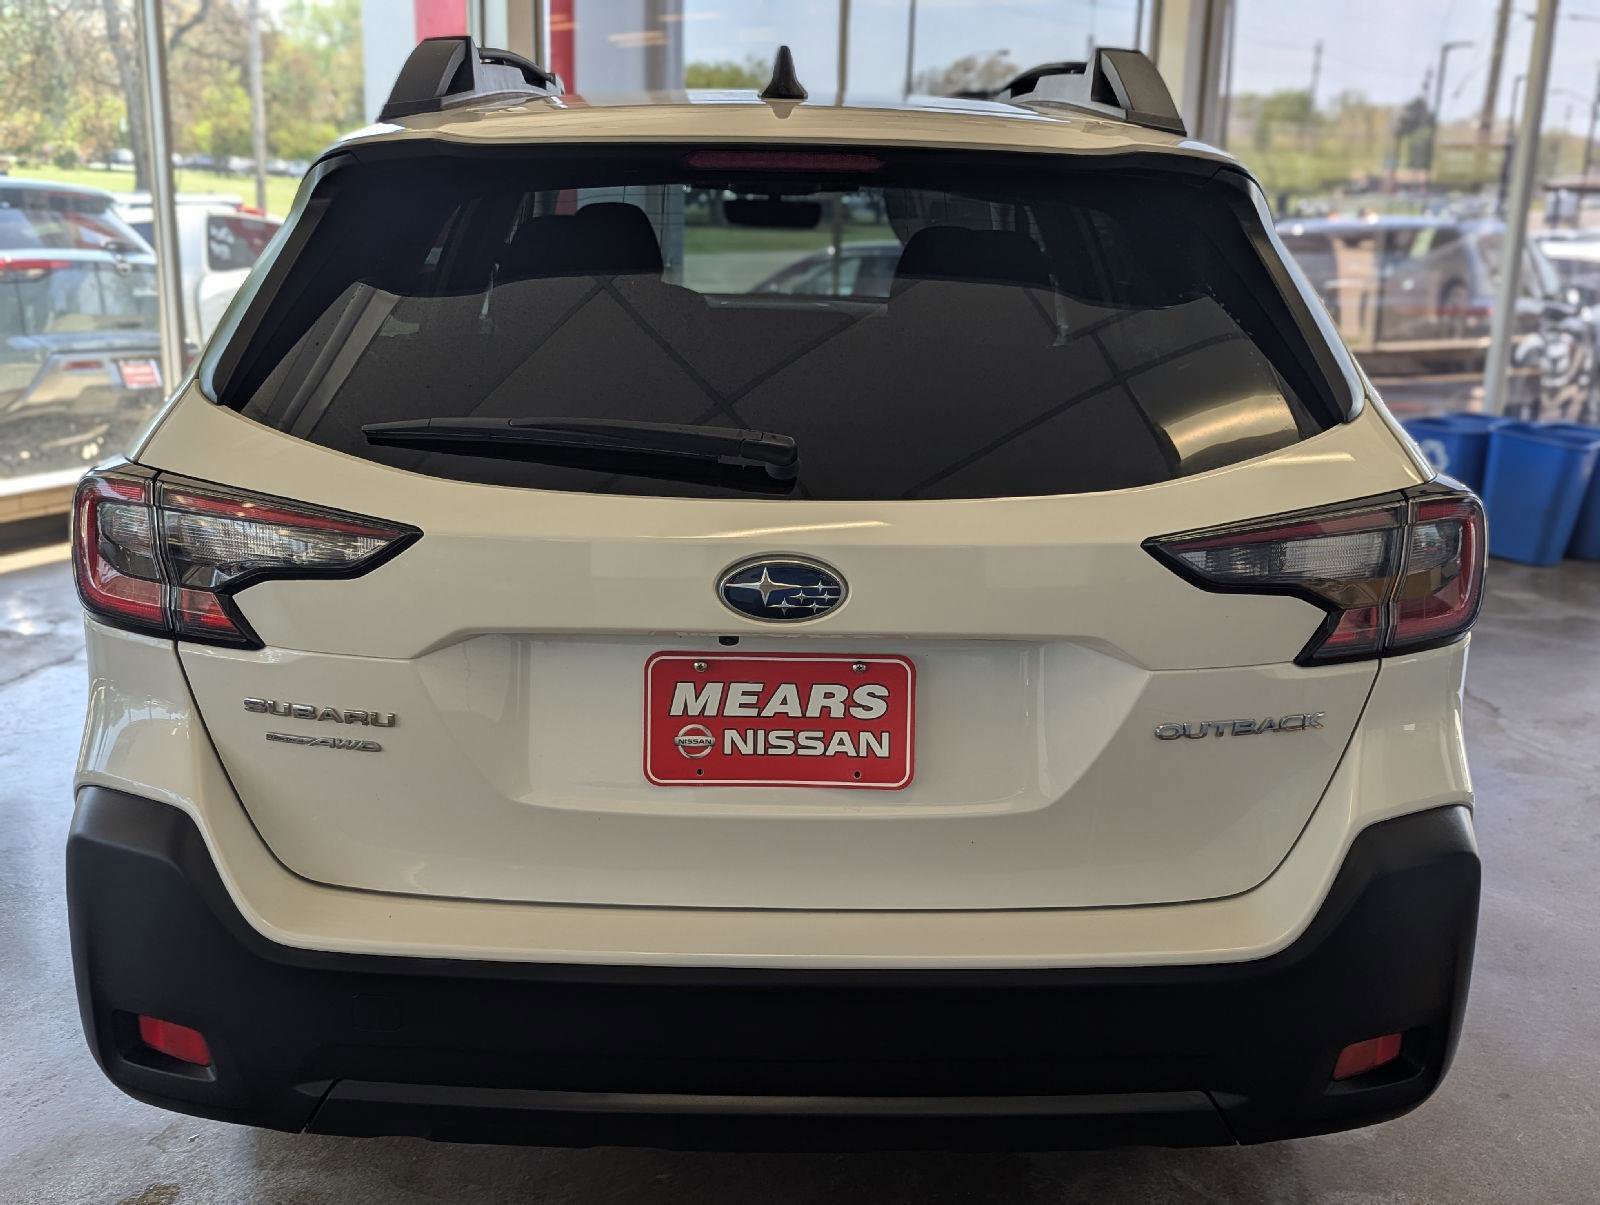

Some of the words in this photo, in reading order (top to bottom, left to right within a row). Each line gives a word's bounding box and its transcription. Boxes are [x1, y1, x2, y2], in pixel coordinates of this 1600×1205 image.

[243, 697, 396, 728] SUBARU
[668, 681, 891, 719] MEARS
[1154, 711, 1325, 740] OUTBACK
[307, 736, 383, 752] AWD
[722, 728, 891, 758] NISSAN
